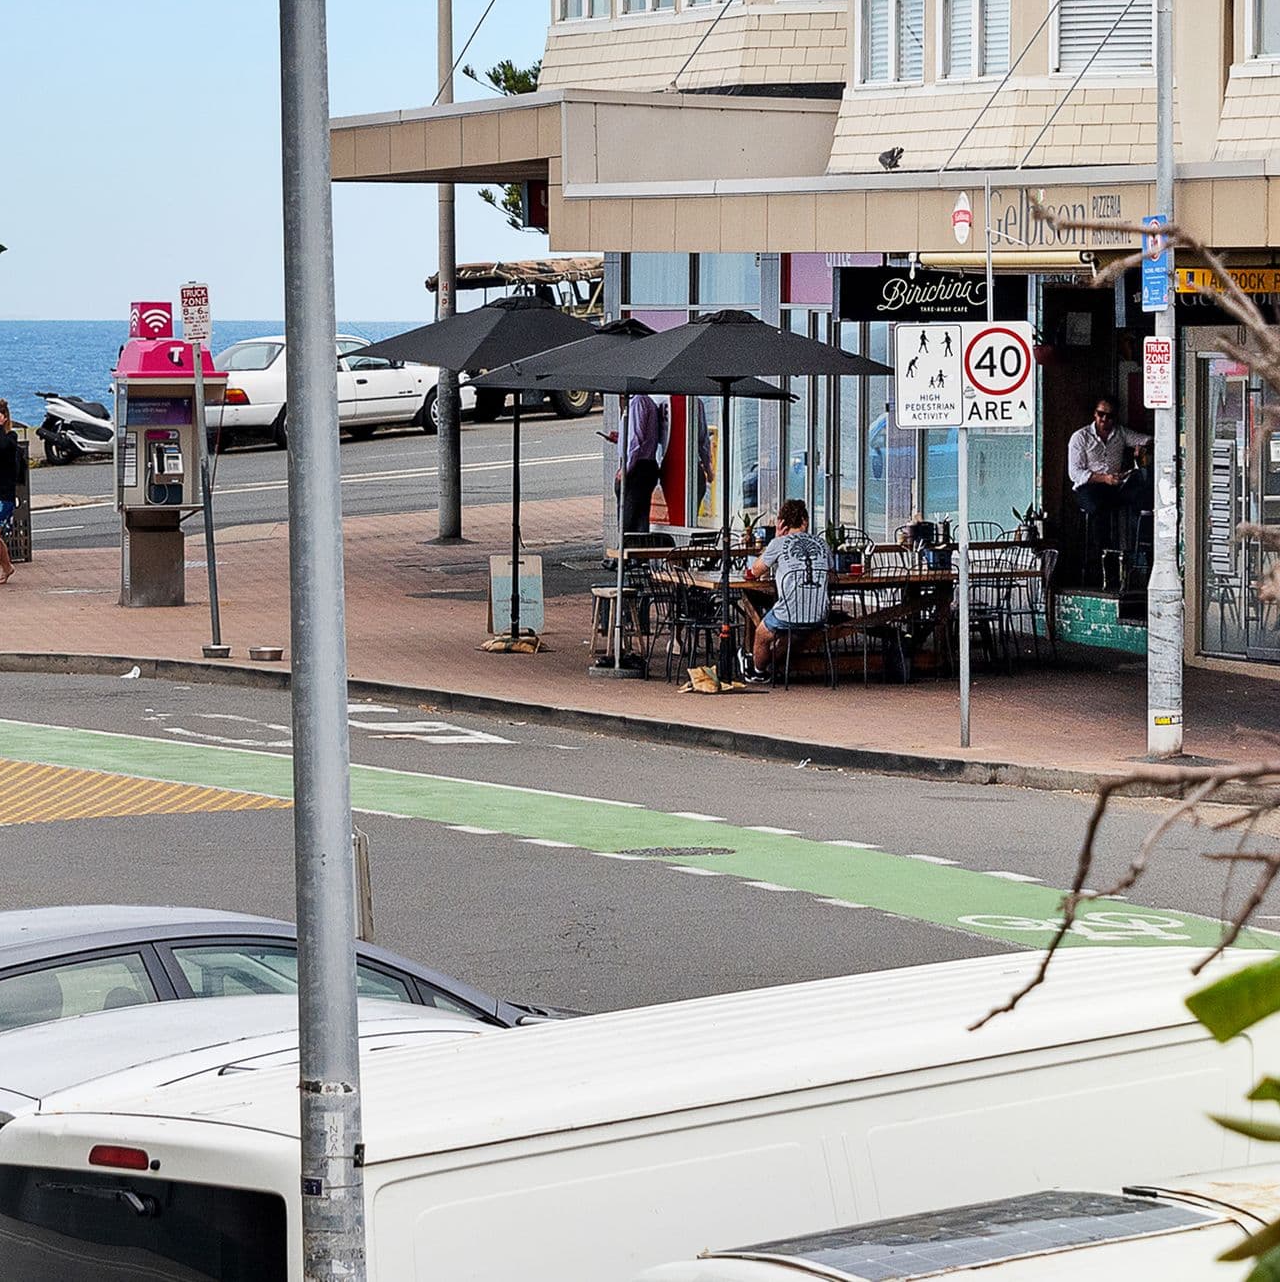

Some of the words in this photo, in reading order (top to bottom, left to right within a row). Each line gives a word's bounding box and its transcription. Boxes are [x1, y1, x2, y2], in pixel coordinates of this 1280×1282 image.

[1092, 195, 1121, 218] PIZZERIA
[182, 288, 207, 298] TRUCK
[877, 276, 988, 310] Birichina
[182, 297, 208, 306] ZONE
[1147, 343, 1169, 352] TRUCK
[974, 346, 1021, 378] 40
[1146, 354, 1170, 363] ZONE
[905, 403, 955, 411] PEDESTRIAN
[912, 412, 949, 420] ACTIVITY
